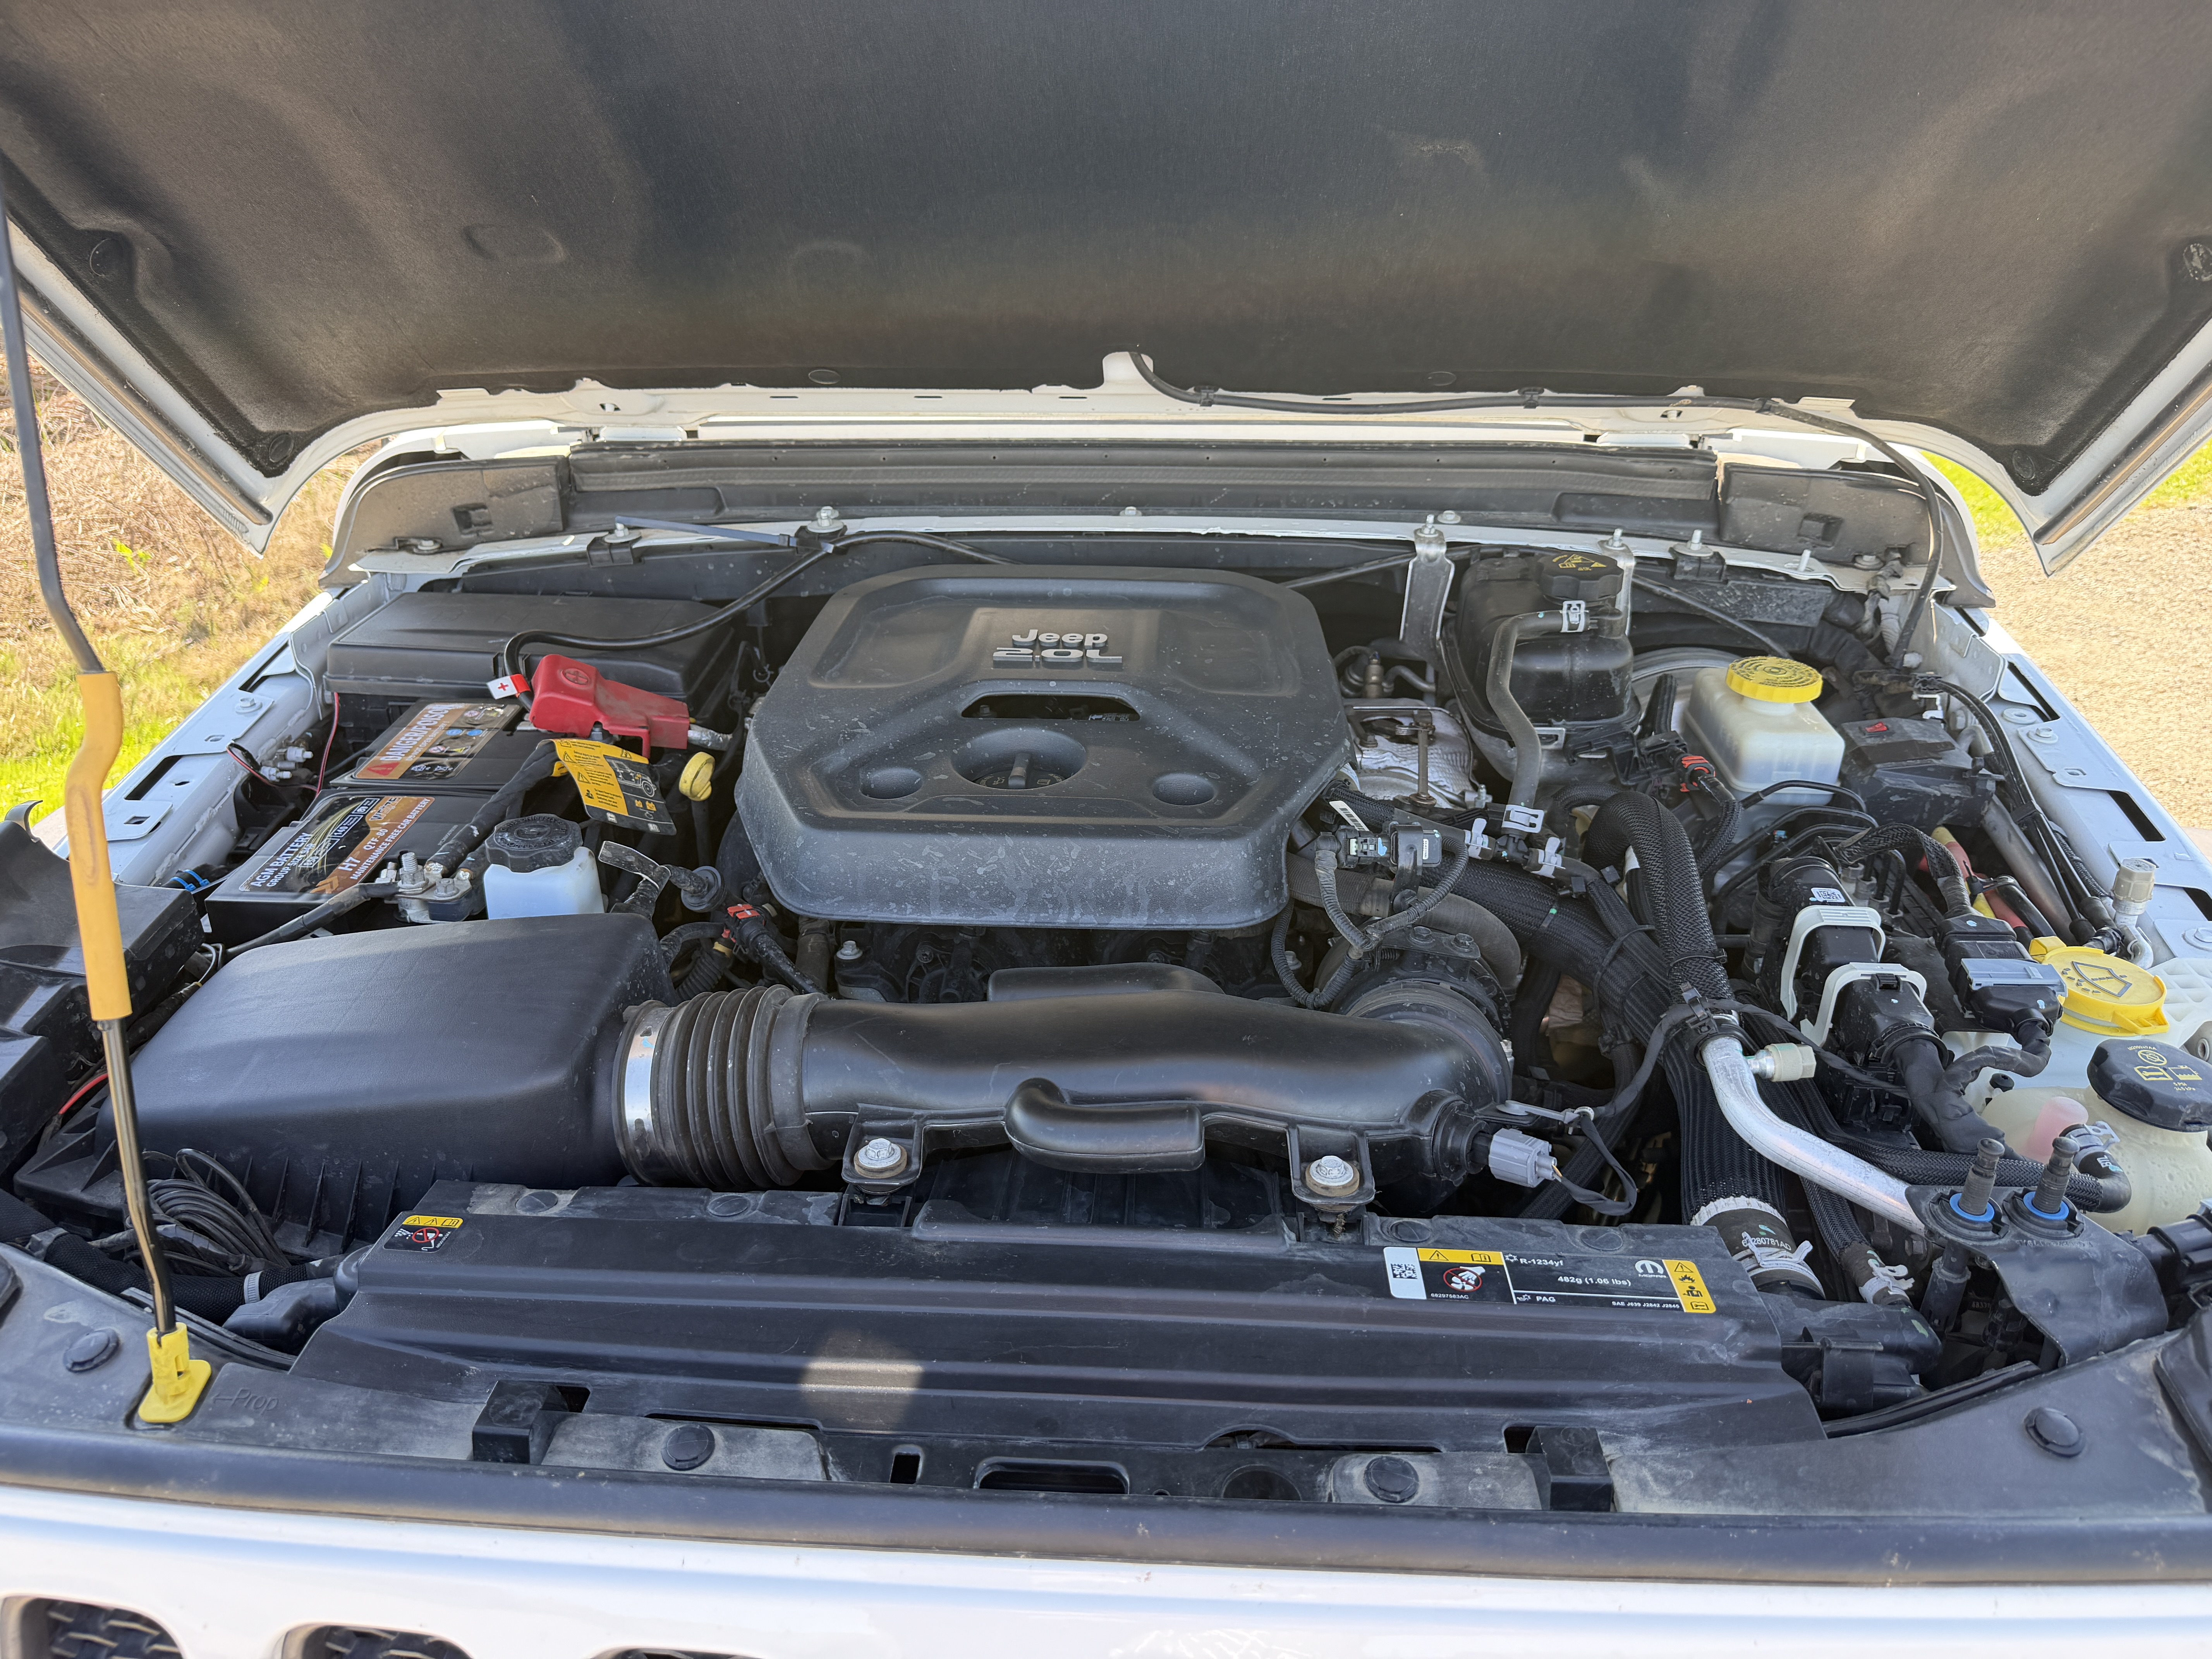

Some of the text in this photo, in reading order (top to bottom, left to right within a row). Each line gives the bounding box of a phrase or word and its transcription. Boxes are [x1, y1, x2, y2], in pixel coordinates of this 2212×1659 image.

[1012, 629, 1108, 649] Jeep
[993, 647, 1122, 663] 2.0L
[380, 704, 455, 761] DANGER/POISON
[334, 826, 348, 836] 140
[350, 840, 390, 879] MAINTENANCE
[385, 828, 402, 843] FREE
[397, 818, 412, 830] CAR
[407, 798, 431, 819] BATTERY
[251, 832, 314, 887] AGM BATTERY
[338, 828, 388, 871] H7 QTF-80
[266, 866, 291, 887] GROUP
[290, 853, 303, 866] SIZE
[304, 856, 319, 866] 850
[1741, 1237, 1791, 1250] 6280781AD
[1520, 1258, 1564, 1267] R-1234yf
[1558, 1276, 1583, 1284] 482g
[1612, 1278, 1632, 1286] lbs)
[231, 1387, 279, 1416] Prop
